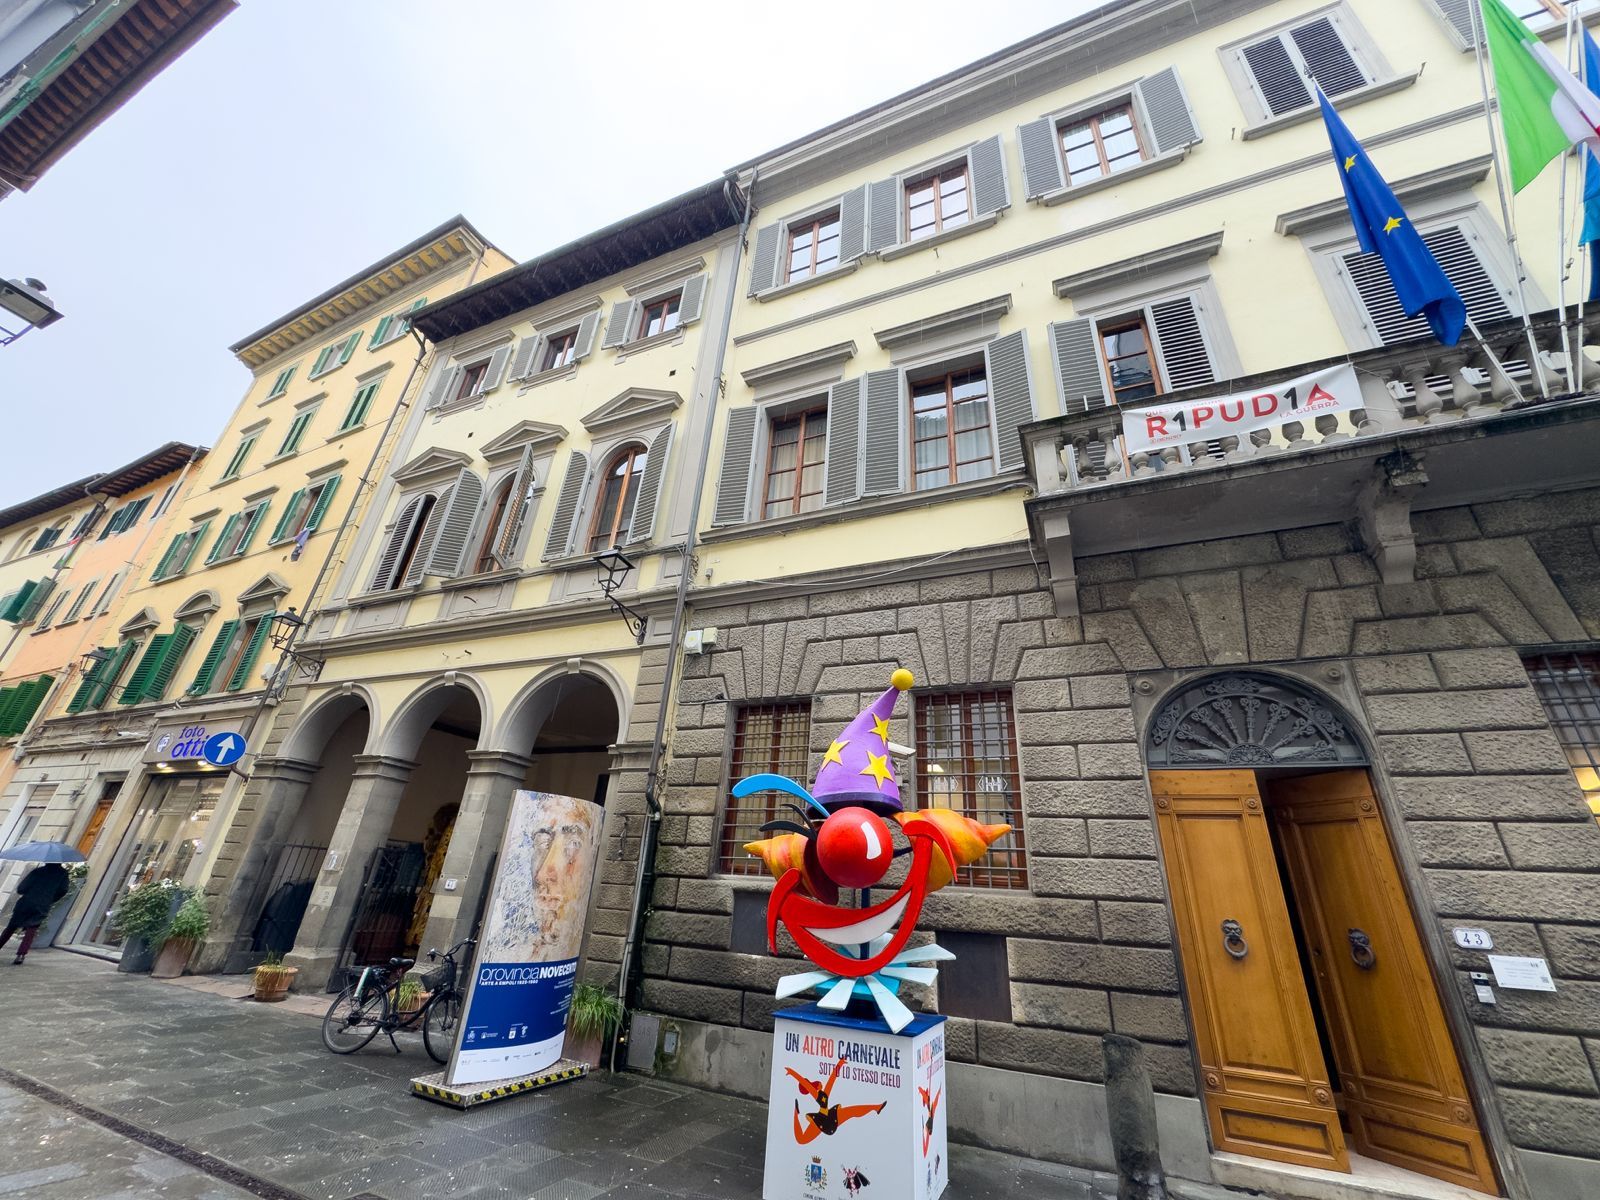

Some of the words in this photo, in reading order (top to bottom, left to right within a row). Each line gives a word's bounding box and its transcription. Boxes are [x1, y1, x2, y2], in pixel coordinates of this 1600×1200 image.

[1145, 383, 1336, 438] R1PUD1A
[1295, 400, 1340, 415] GUERRA
[179, 725, 206, 740] foto
[171, 734, 210, 759] otti
[1463, 932, 1484, 946] 43
[479, 966, 540, 985] provincia
[785, 1032, 800, 1053] UN
[802, 1035, 835, 1059] ALTRO
[837, 1040, 901, 1070] CARNEVALE
[842, 1065, 851, 1080] LO
[852, 1067, 879, 1085] STESSO
[880, 1071, 901, 1089] CIELO
